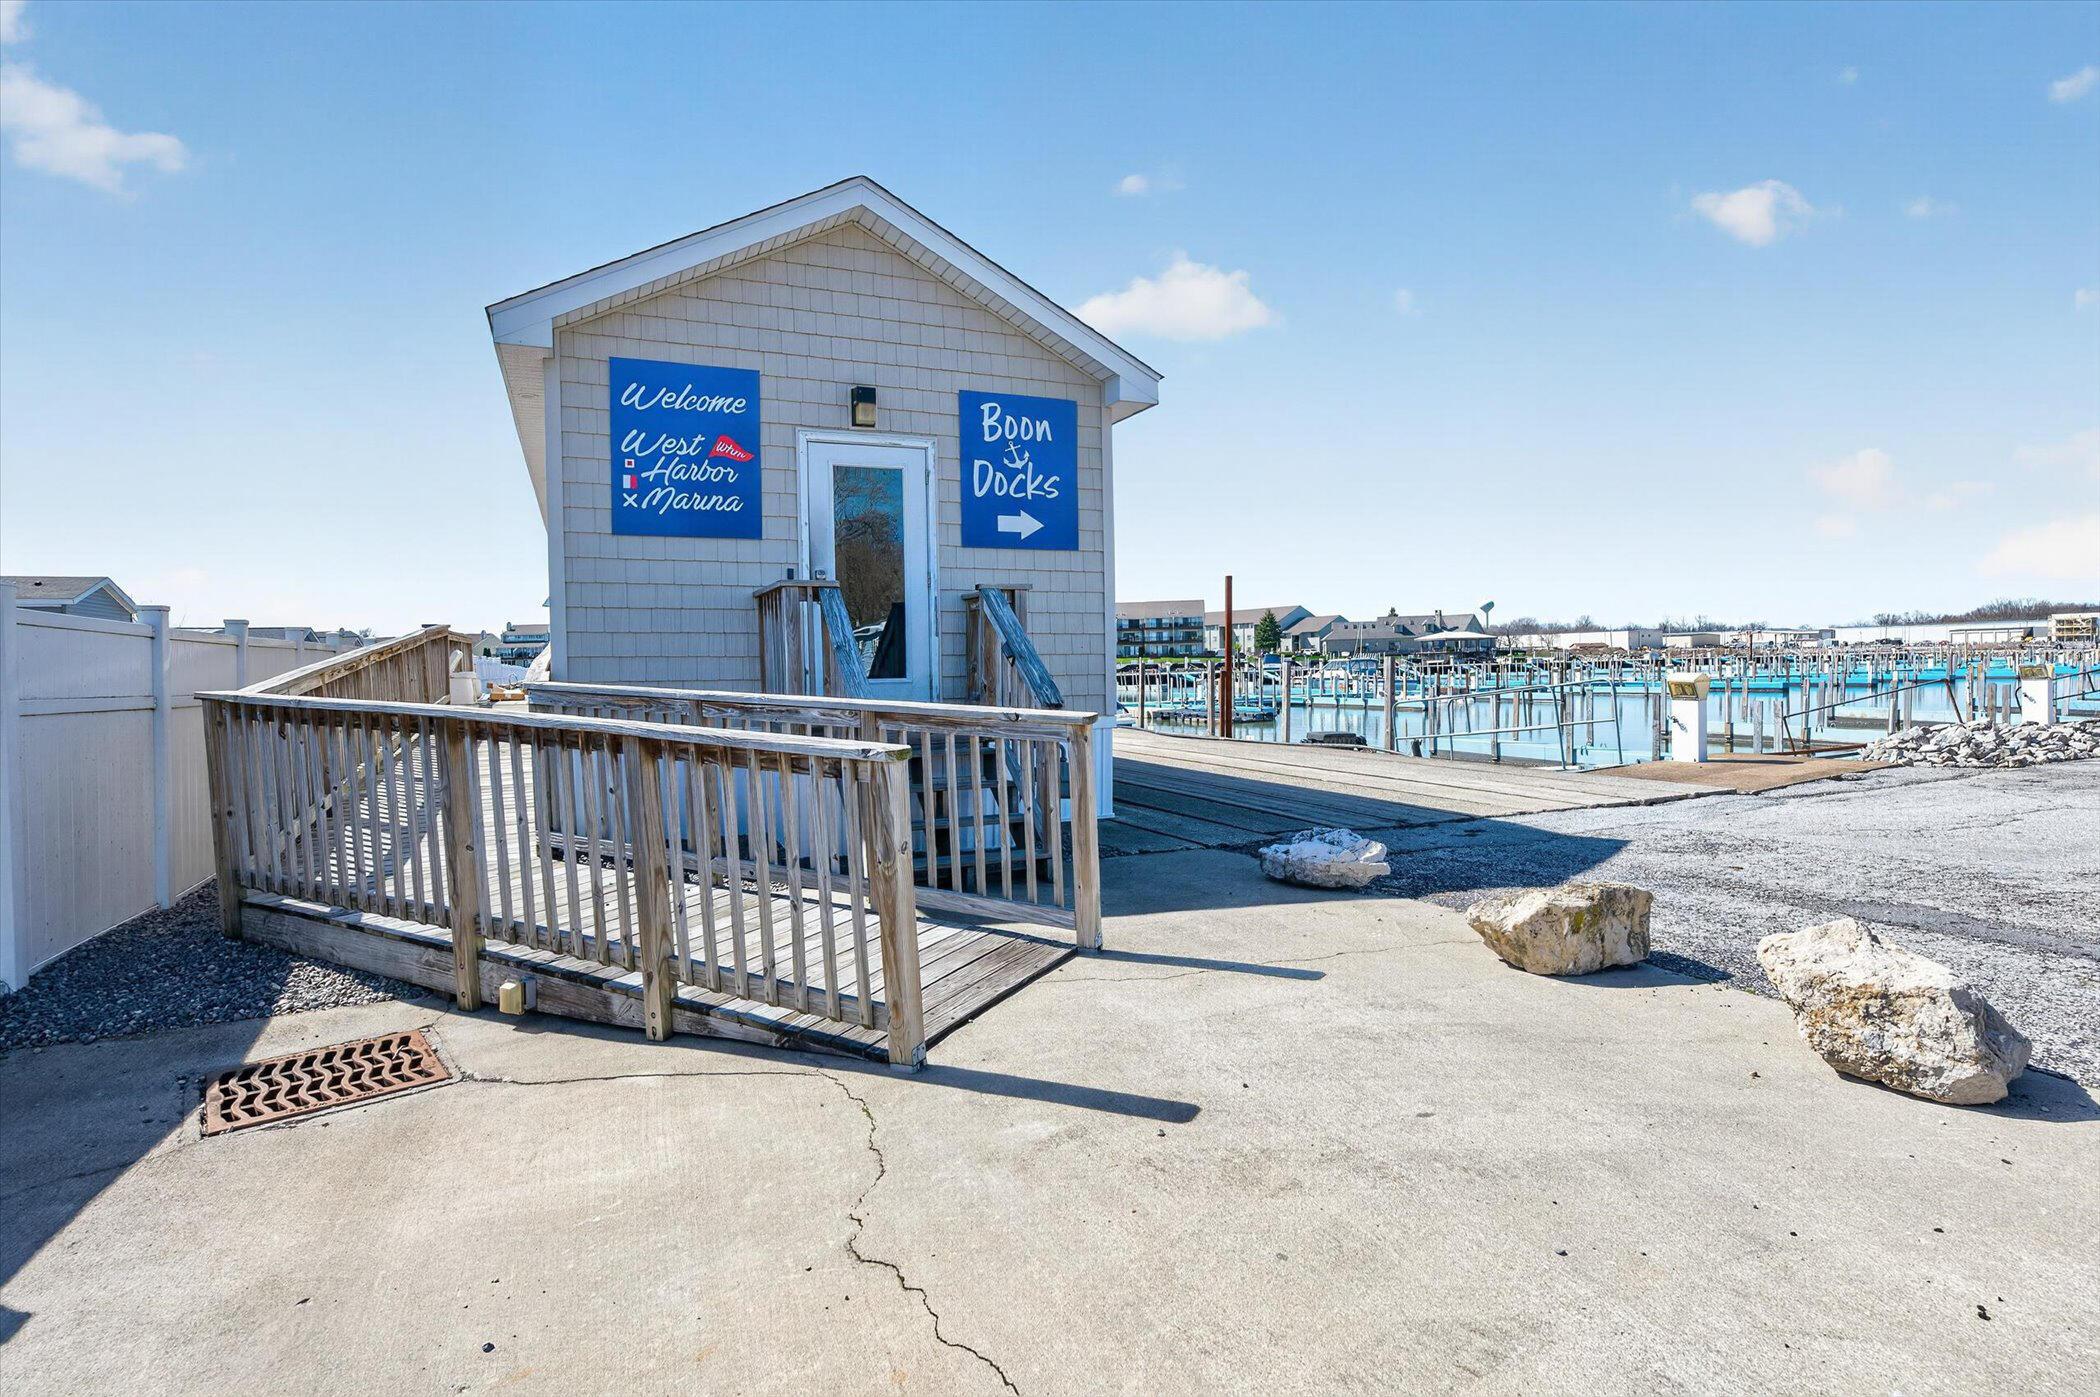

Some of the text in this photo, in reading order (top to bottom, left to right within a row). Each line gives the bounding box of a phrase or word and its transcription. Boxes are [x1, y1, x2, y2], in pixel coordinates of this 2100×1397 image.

[620, 382, 747, 414] Welcome
[980, 402, 1053, 442] Boon
[620, 429, 706, 457] West
[640, 456, 739, 486] Harbor
[973, 459, 1060, 500] Docks
[641, 486, 744, 515] Marina
